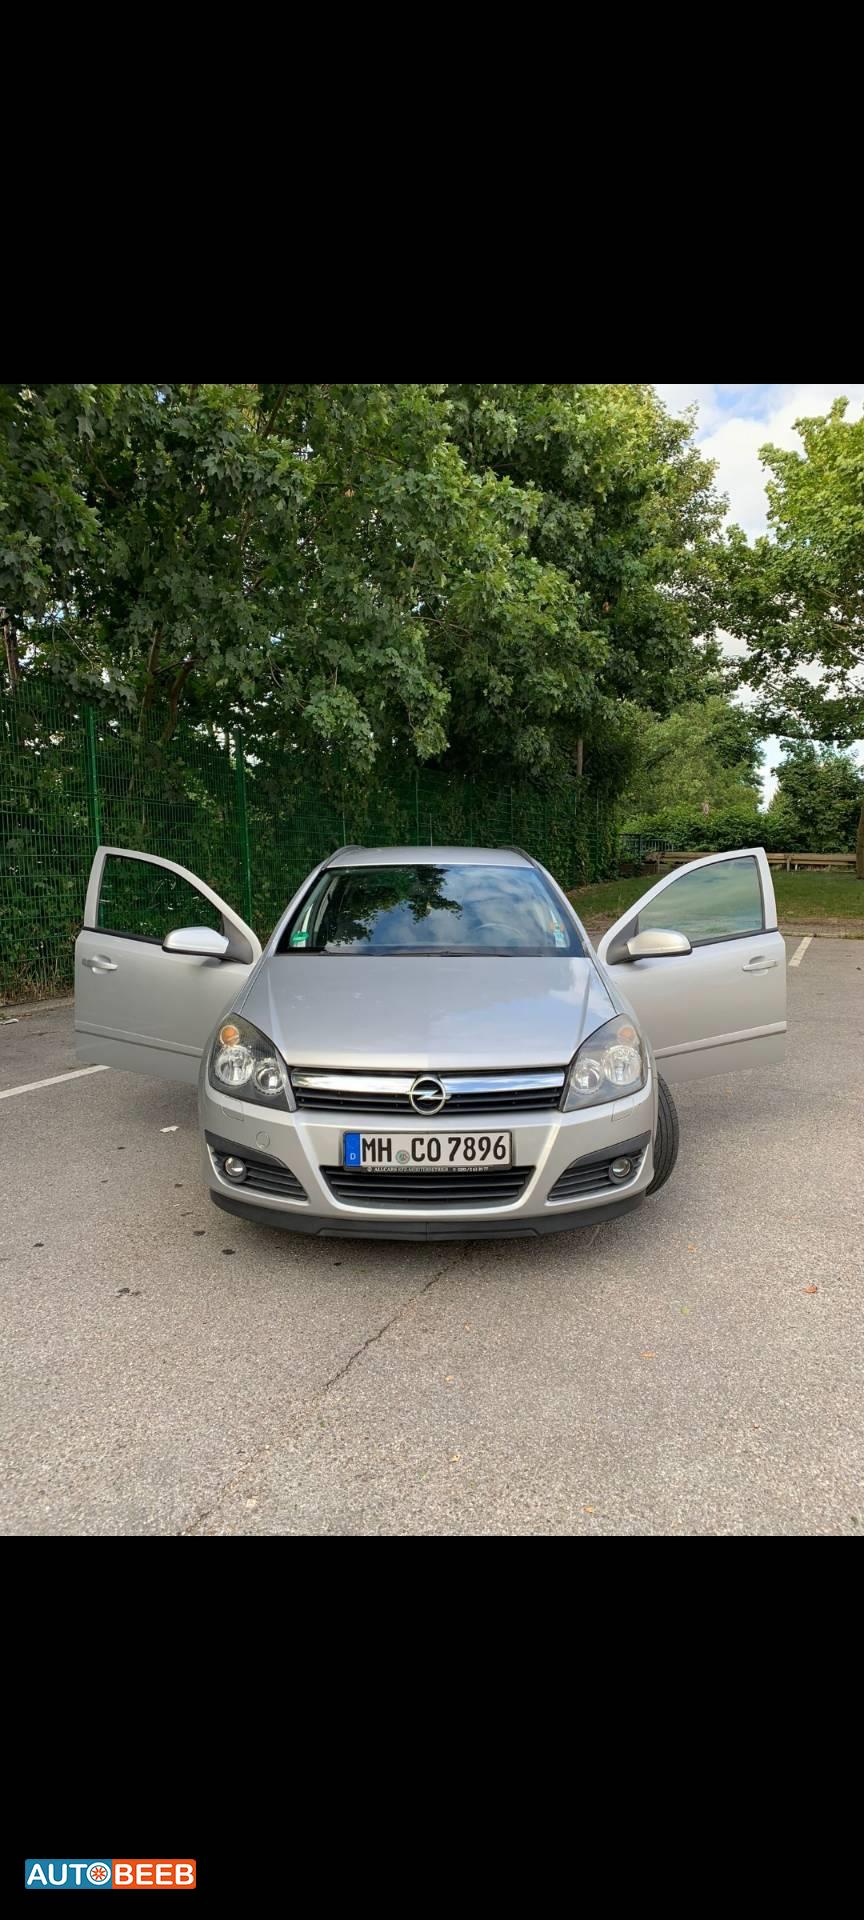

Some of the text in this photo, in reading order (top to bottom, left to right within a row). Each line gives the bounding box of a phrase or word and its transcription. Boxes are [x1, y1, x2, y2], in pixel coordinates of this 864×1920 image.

[362, 1138, 392, 1162] MH
[411, 1137, 441, 1162] CO
[448, 1135, 506, 1161] 7896
